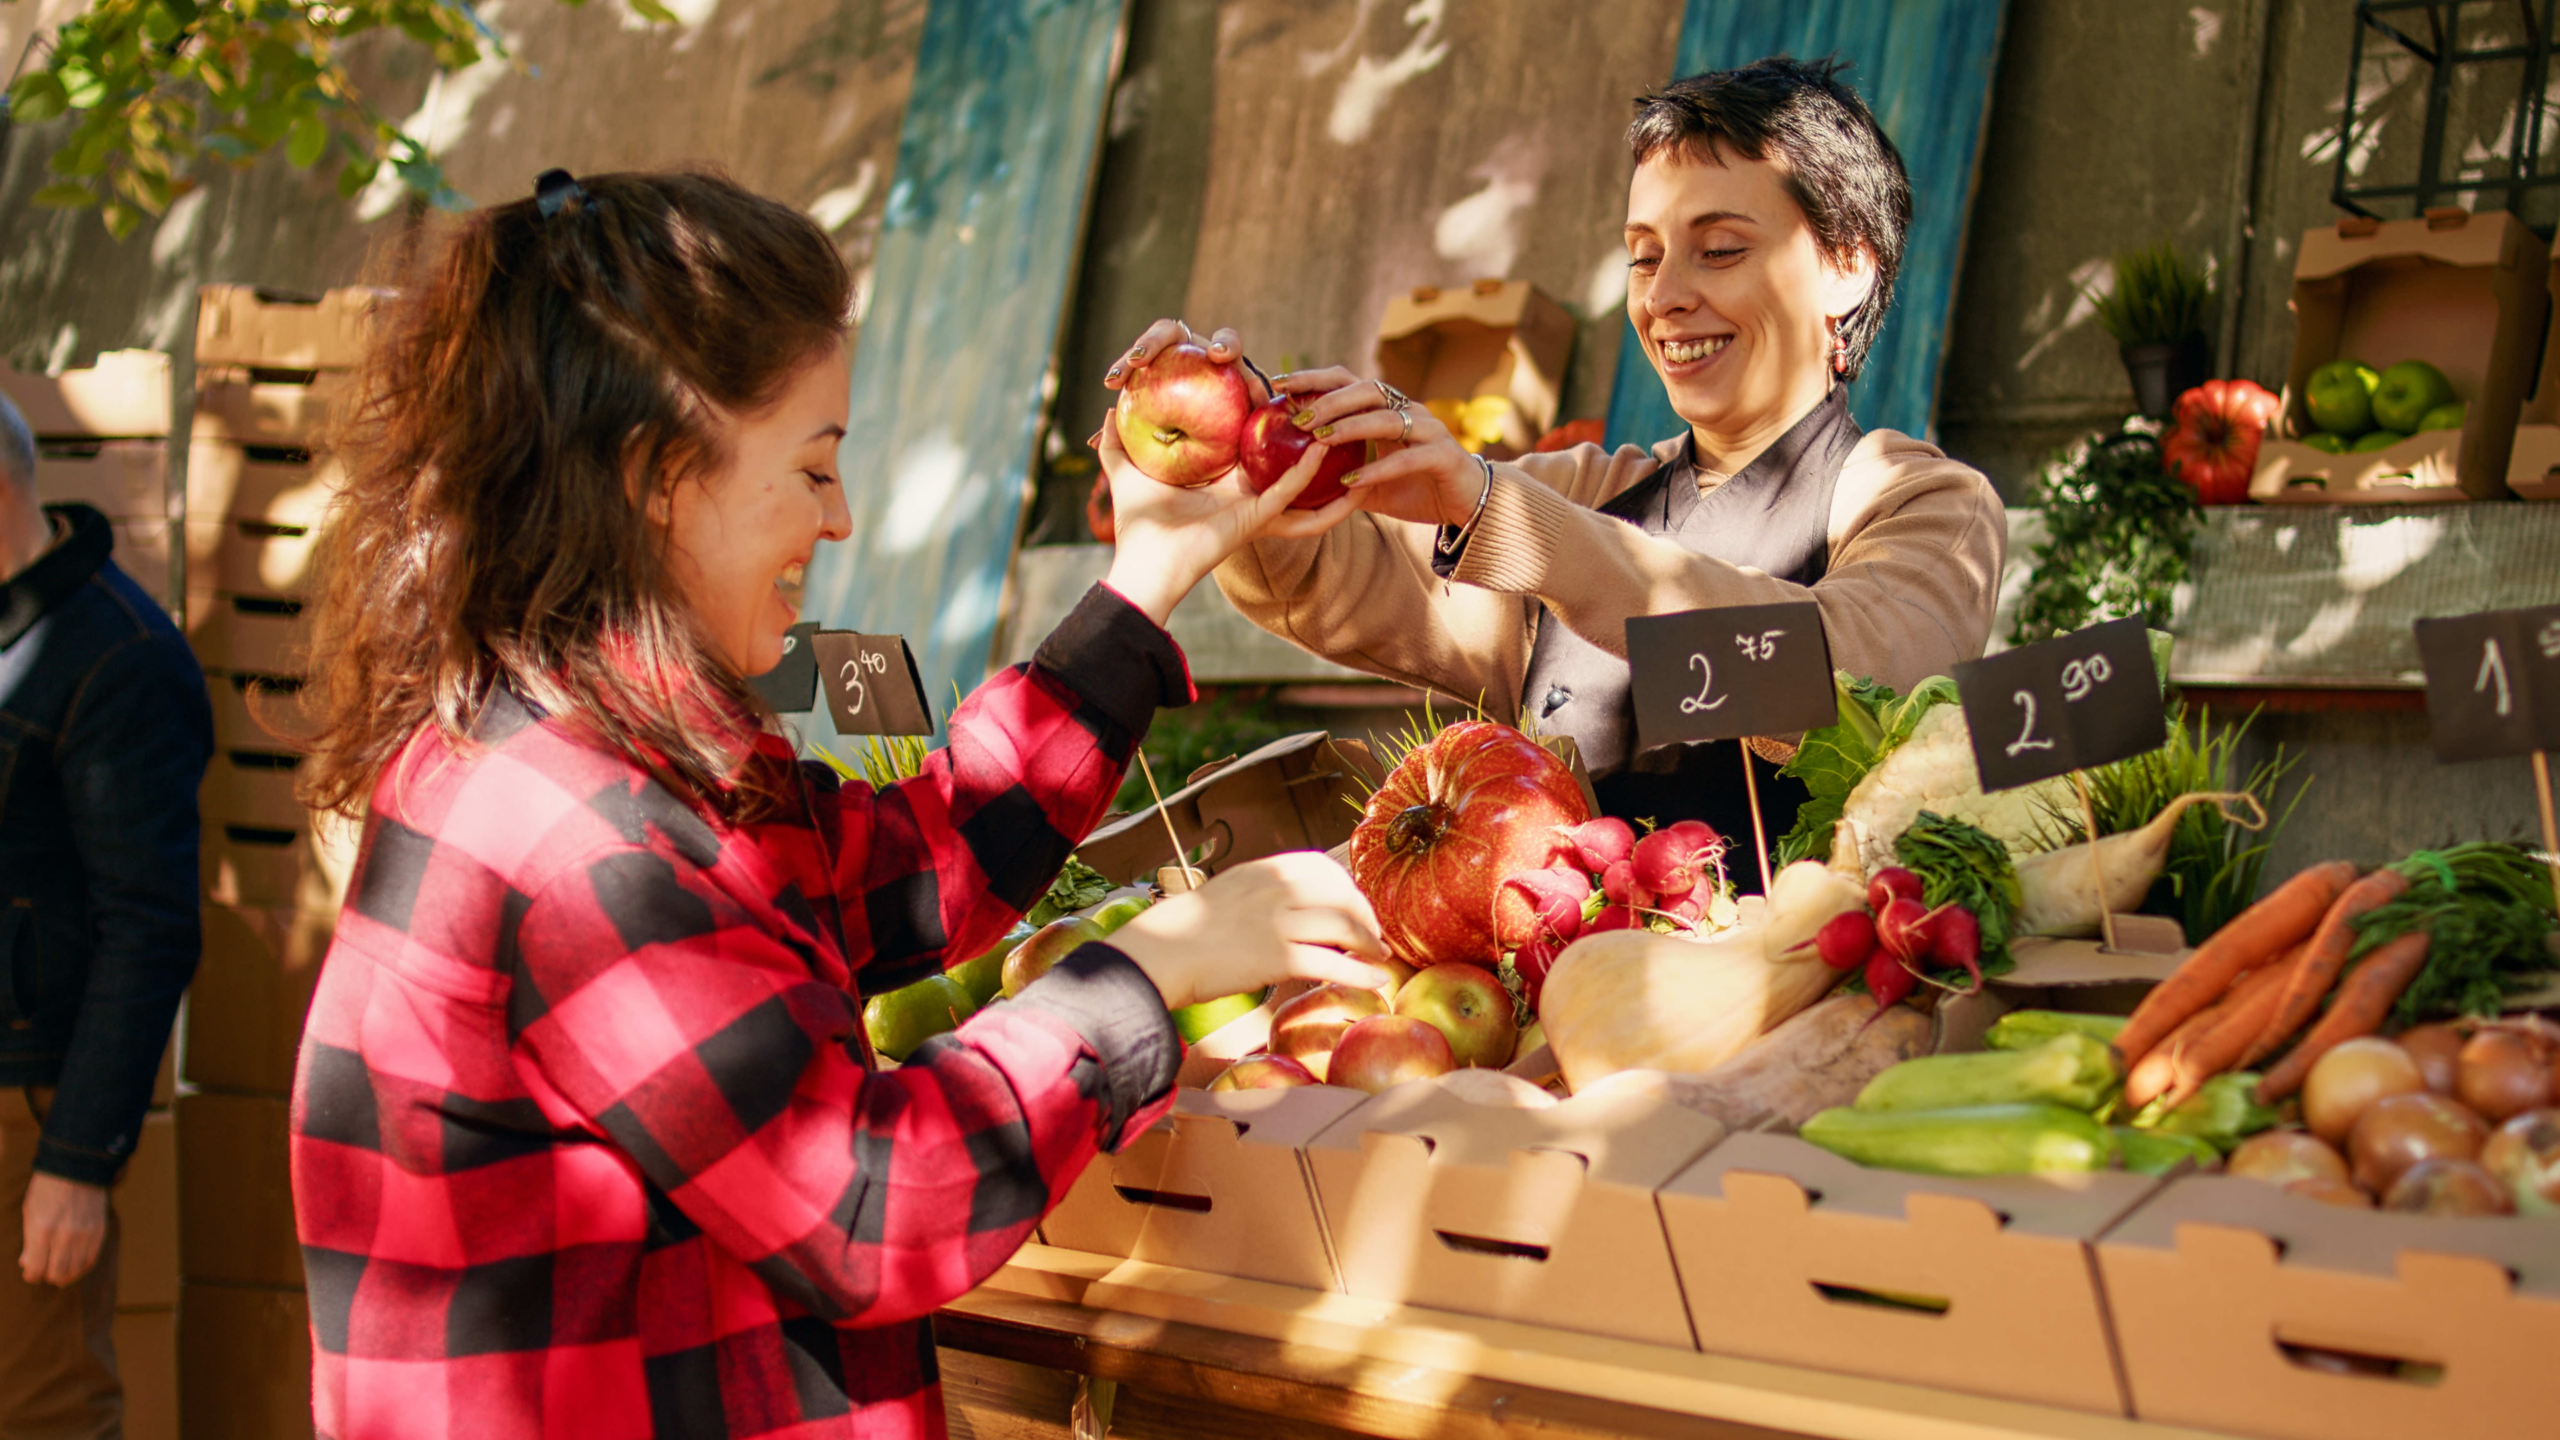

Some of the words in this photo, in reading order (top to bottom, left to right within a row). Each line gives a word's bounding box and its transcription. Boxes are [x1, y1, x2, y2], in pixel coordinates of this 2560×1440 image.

[840, 660, 864, 715] 3
[860, 649, 886, 673] 40
[1680, 653, 1729, 714] 2
[1735, 630, 1787, 661] 75
[2005, 690, 2055, 757] 2
[2061, 653, 2112, 702] 90
[2474, 638, 2511, 716] 1
